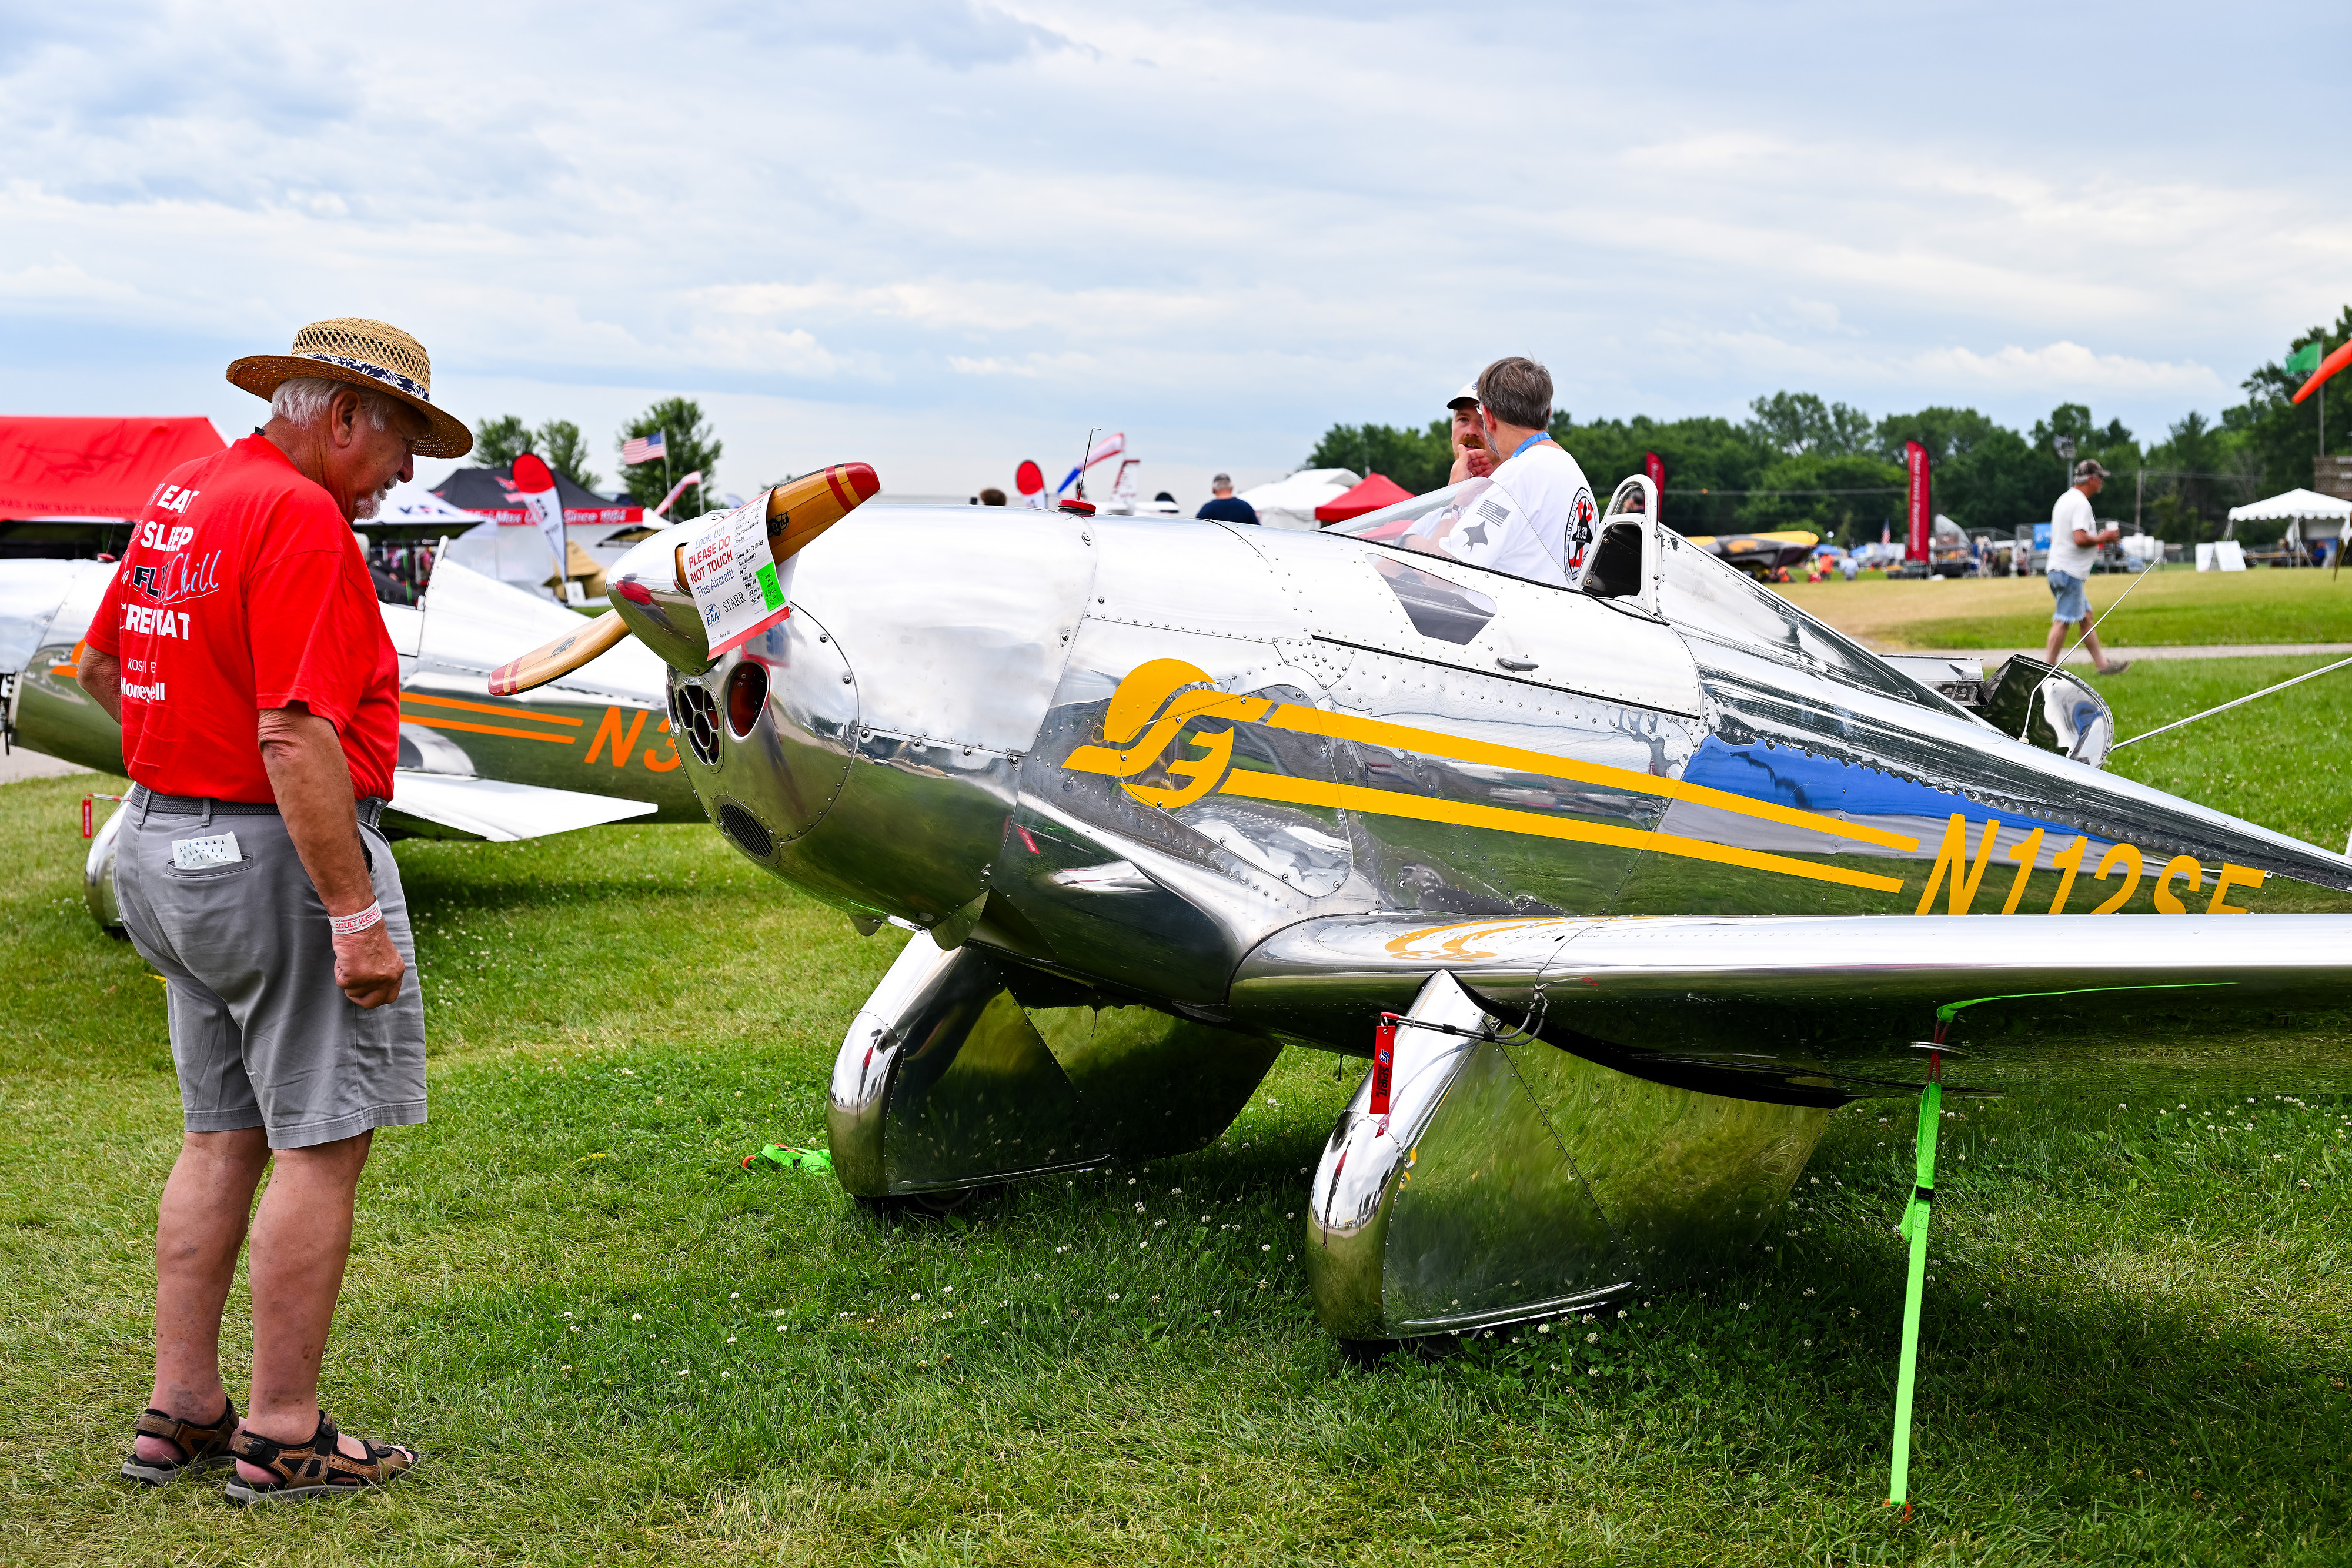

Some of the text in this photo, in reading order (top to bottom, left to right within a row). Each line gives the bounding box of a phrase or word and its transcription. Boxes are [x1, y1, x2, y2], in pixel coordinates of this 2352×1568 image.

[156, 484, 200, 513] EAT
[563, 510, 598, 524] Since
[140, 521, 194, 551] SLEEP
[695, 525, 725, 549] Look, but
[689, 542, 716, 569] PLEASE
[719, 536, 730, 551] DO
[690, 566, 705, 584] NOT
[707, 550, 733, 574] TOUCH
[166, 550, 221, 600] Chill
[696, 567, 734, 598] This Aircraft!
[722, 592, 746, 612] STARR
[707, 612, 719, 626] EAA
[121, 676, 165, 703] Honeyell
[335, 920, 357, 929] ADULT
[359, 907, 380, 924] WEEKLY
[1379, 1066, 1389, 1097] SPIRIT
